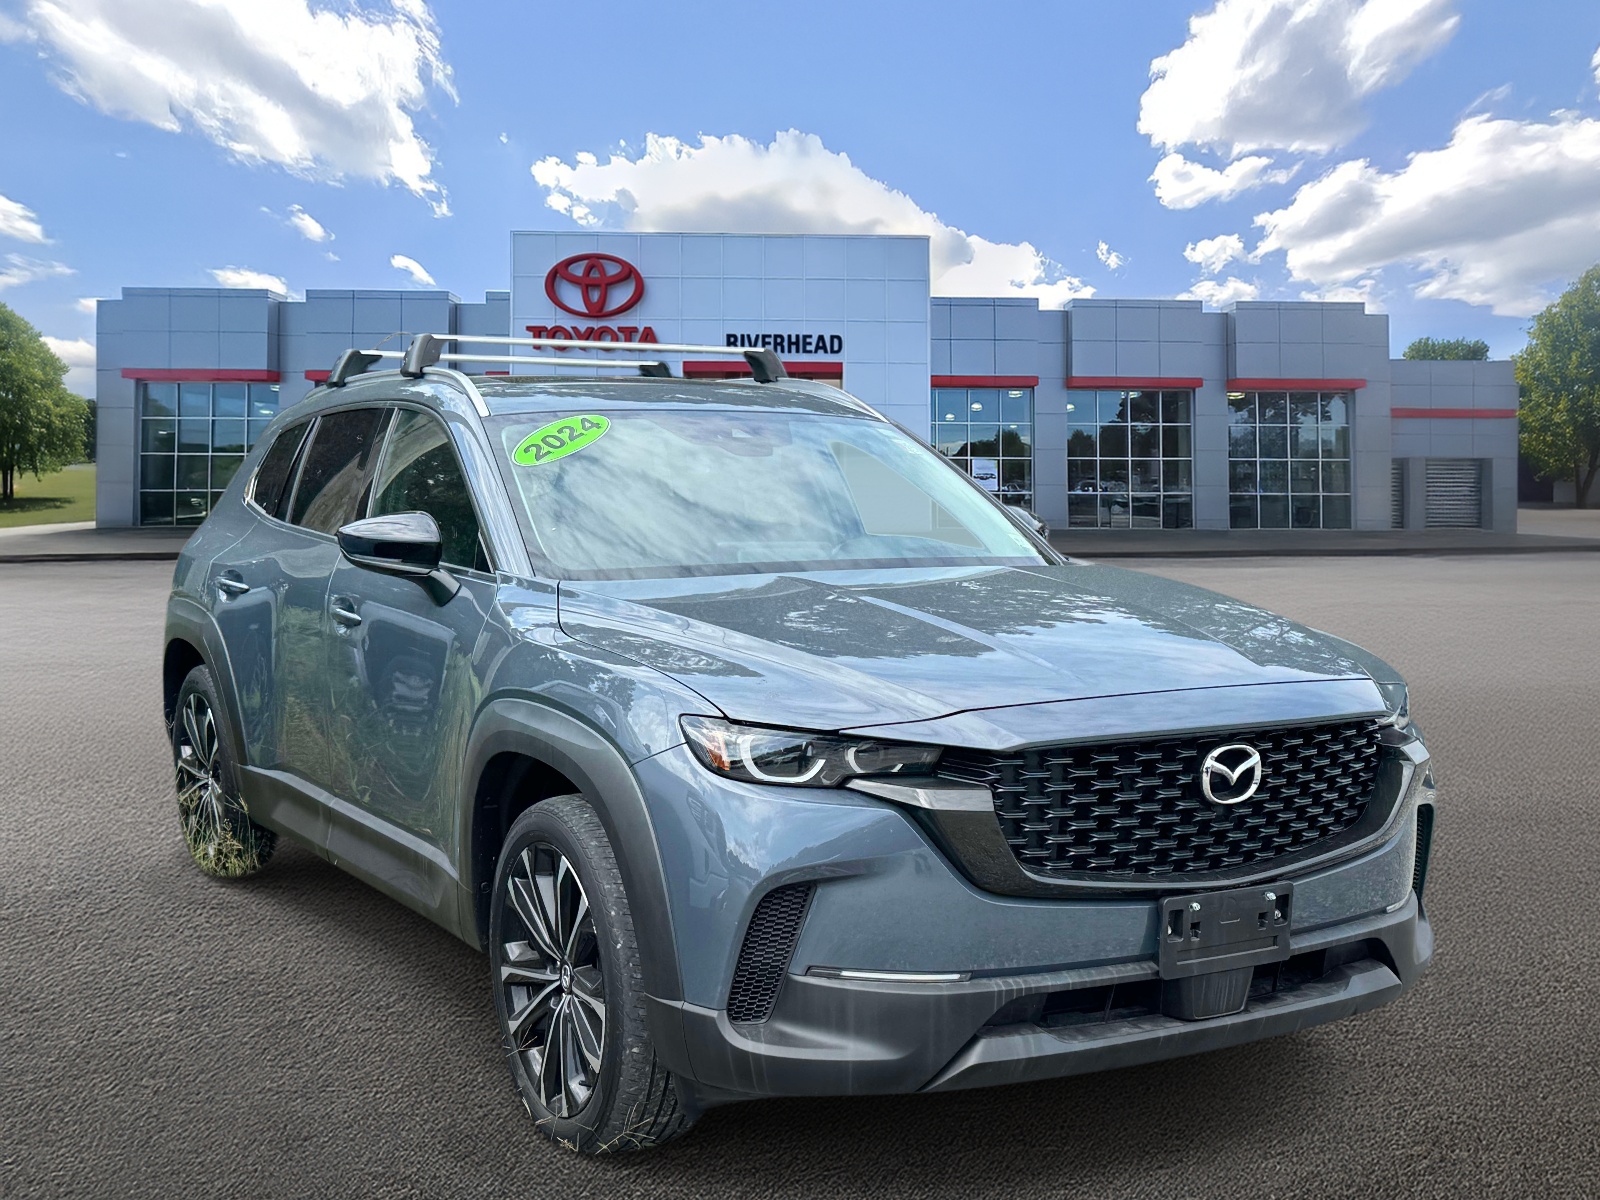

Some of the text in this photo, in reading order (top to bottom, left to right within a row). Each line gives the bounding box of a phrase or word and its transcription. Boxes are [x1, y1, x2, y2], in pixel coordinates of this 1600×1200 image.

[525, 325, 660, 352] TOYOTA
[725, 333, 843, 355] RIVERHEAD
[523, 417, 602, 462] 2024
